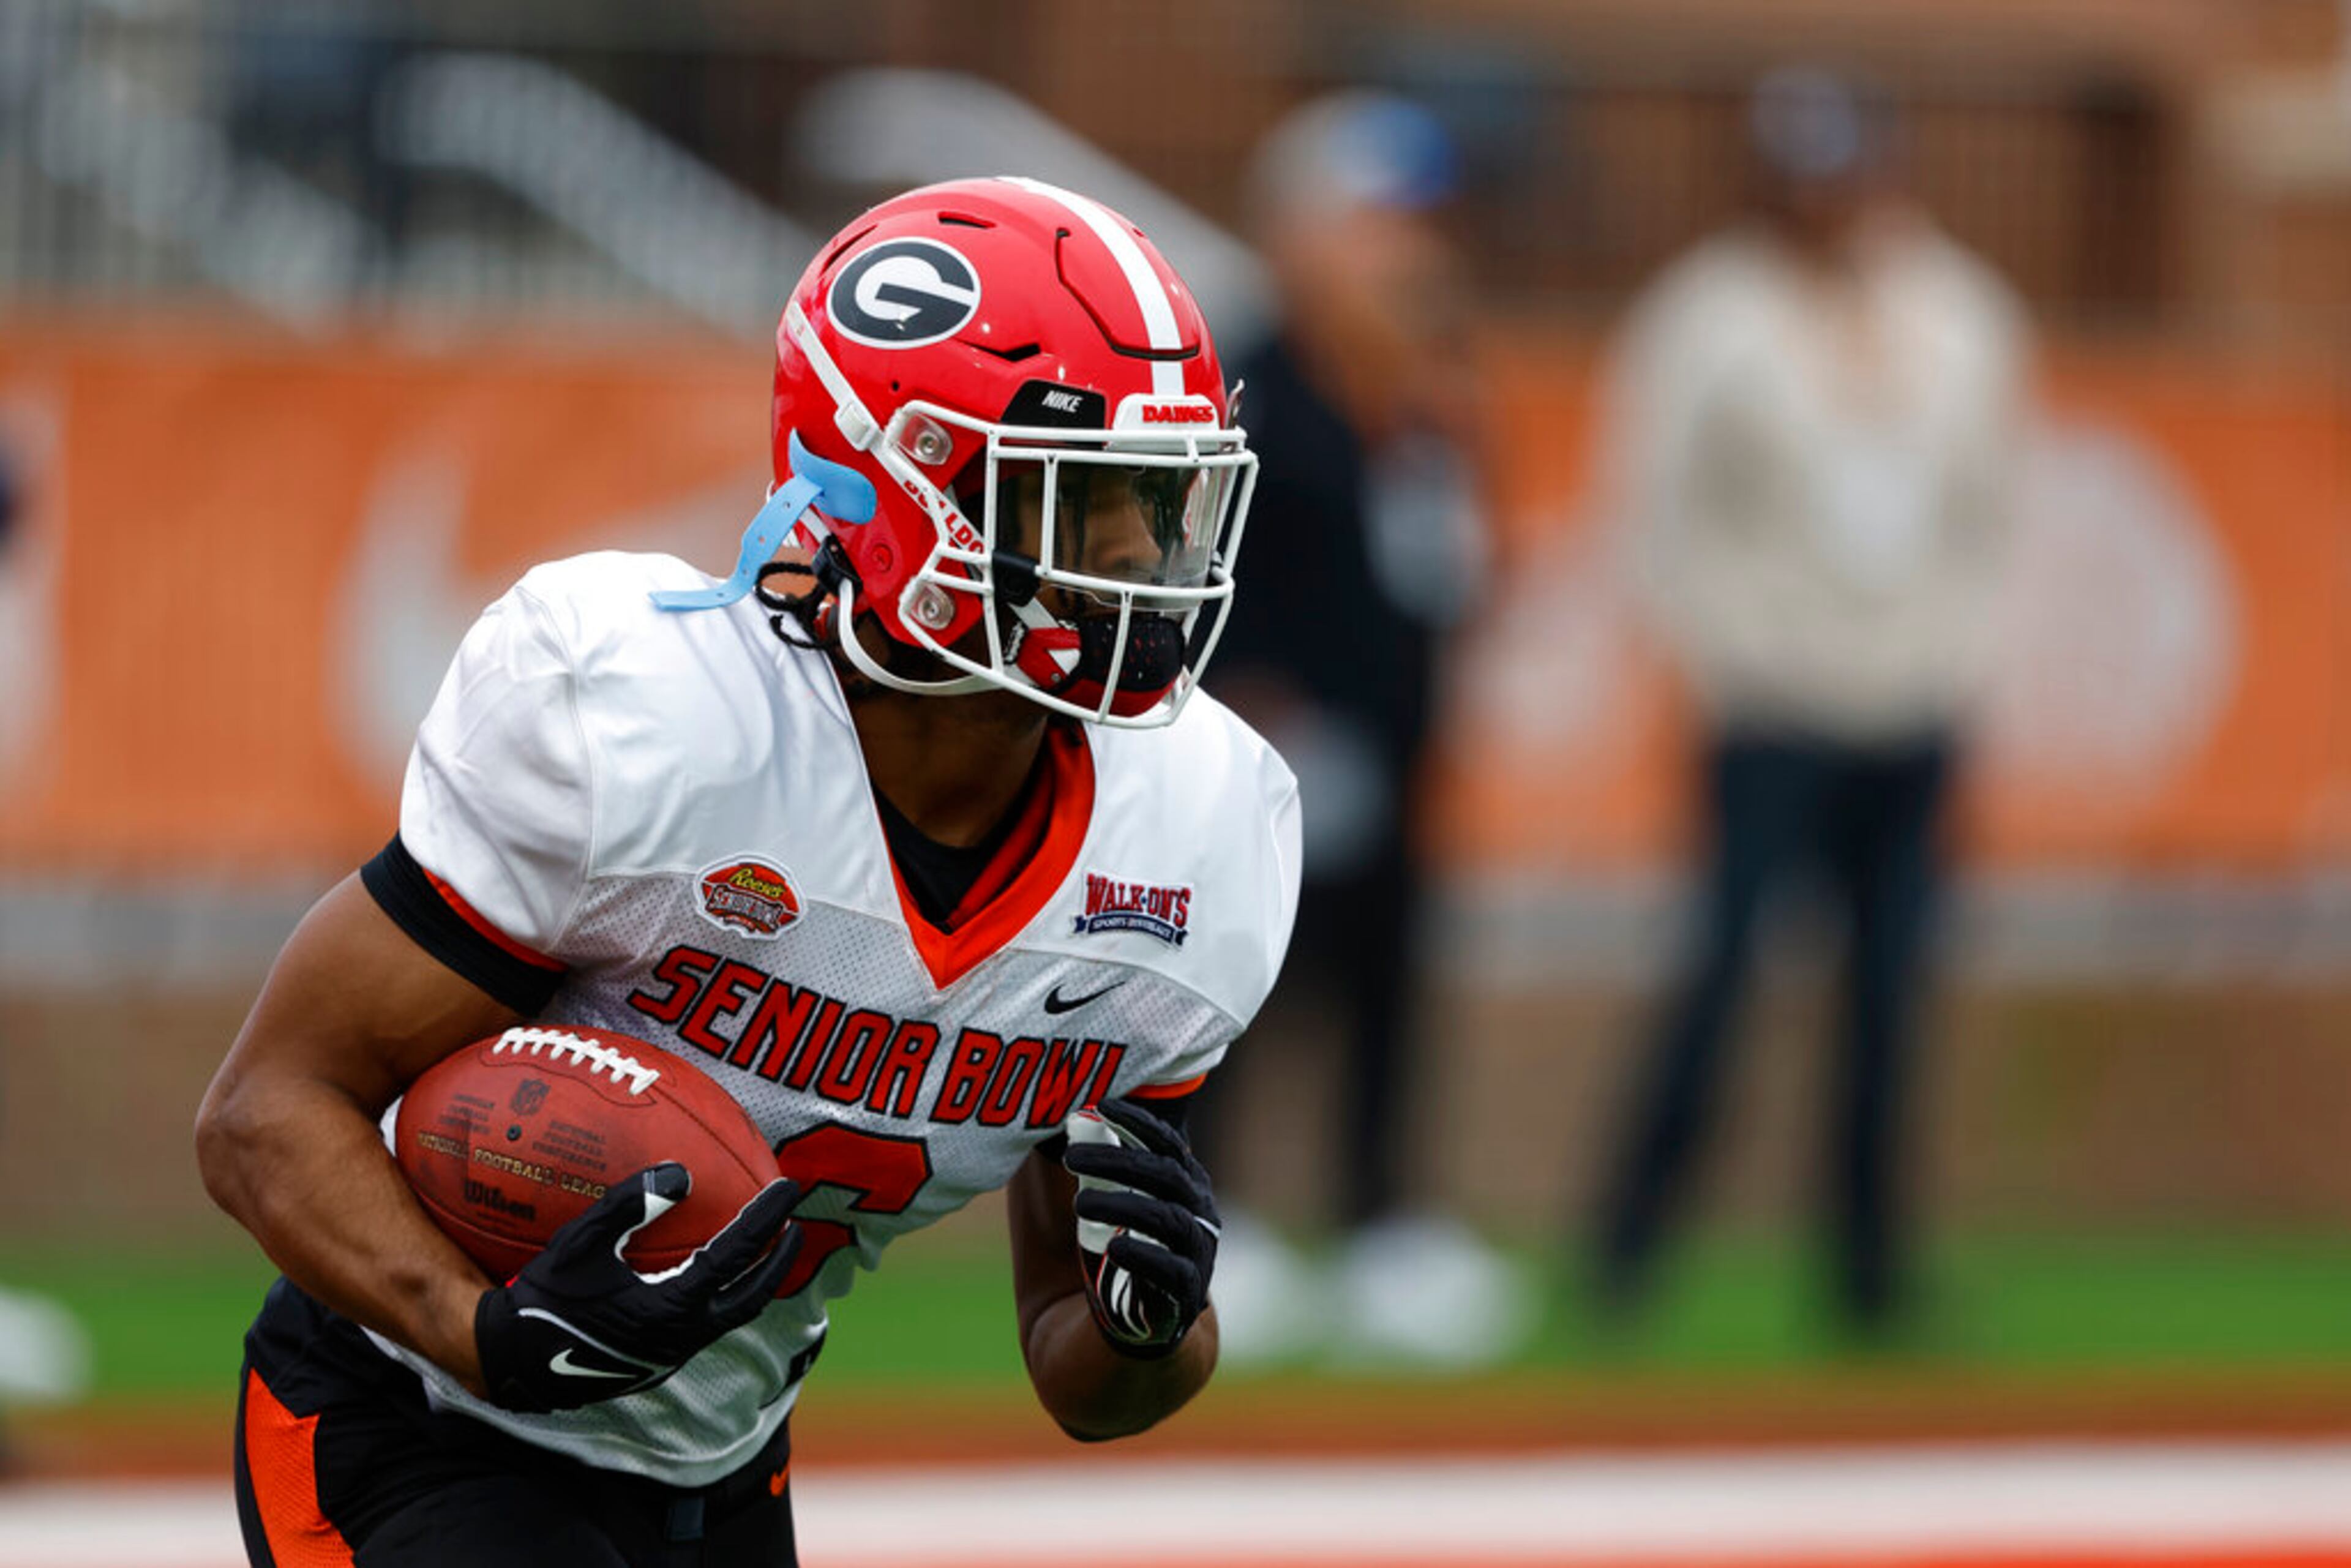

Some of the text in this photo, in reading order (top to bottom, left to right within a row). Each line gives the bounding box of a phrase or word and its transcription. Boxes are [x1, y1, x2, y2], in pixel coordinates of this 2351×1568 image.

[829, 240, 980, 347] G
[1041, 389, 1082, 413] NIKE
[1142, 404, 1215, 423] DAWGS
[626, 945, 941, 1118] SENIOR
[473, 1147, 555, 1186] FOOTBALL
[560, 1172, 607, 1199] LEAG
